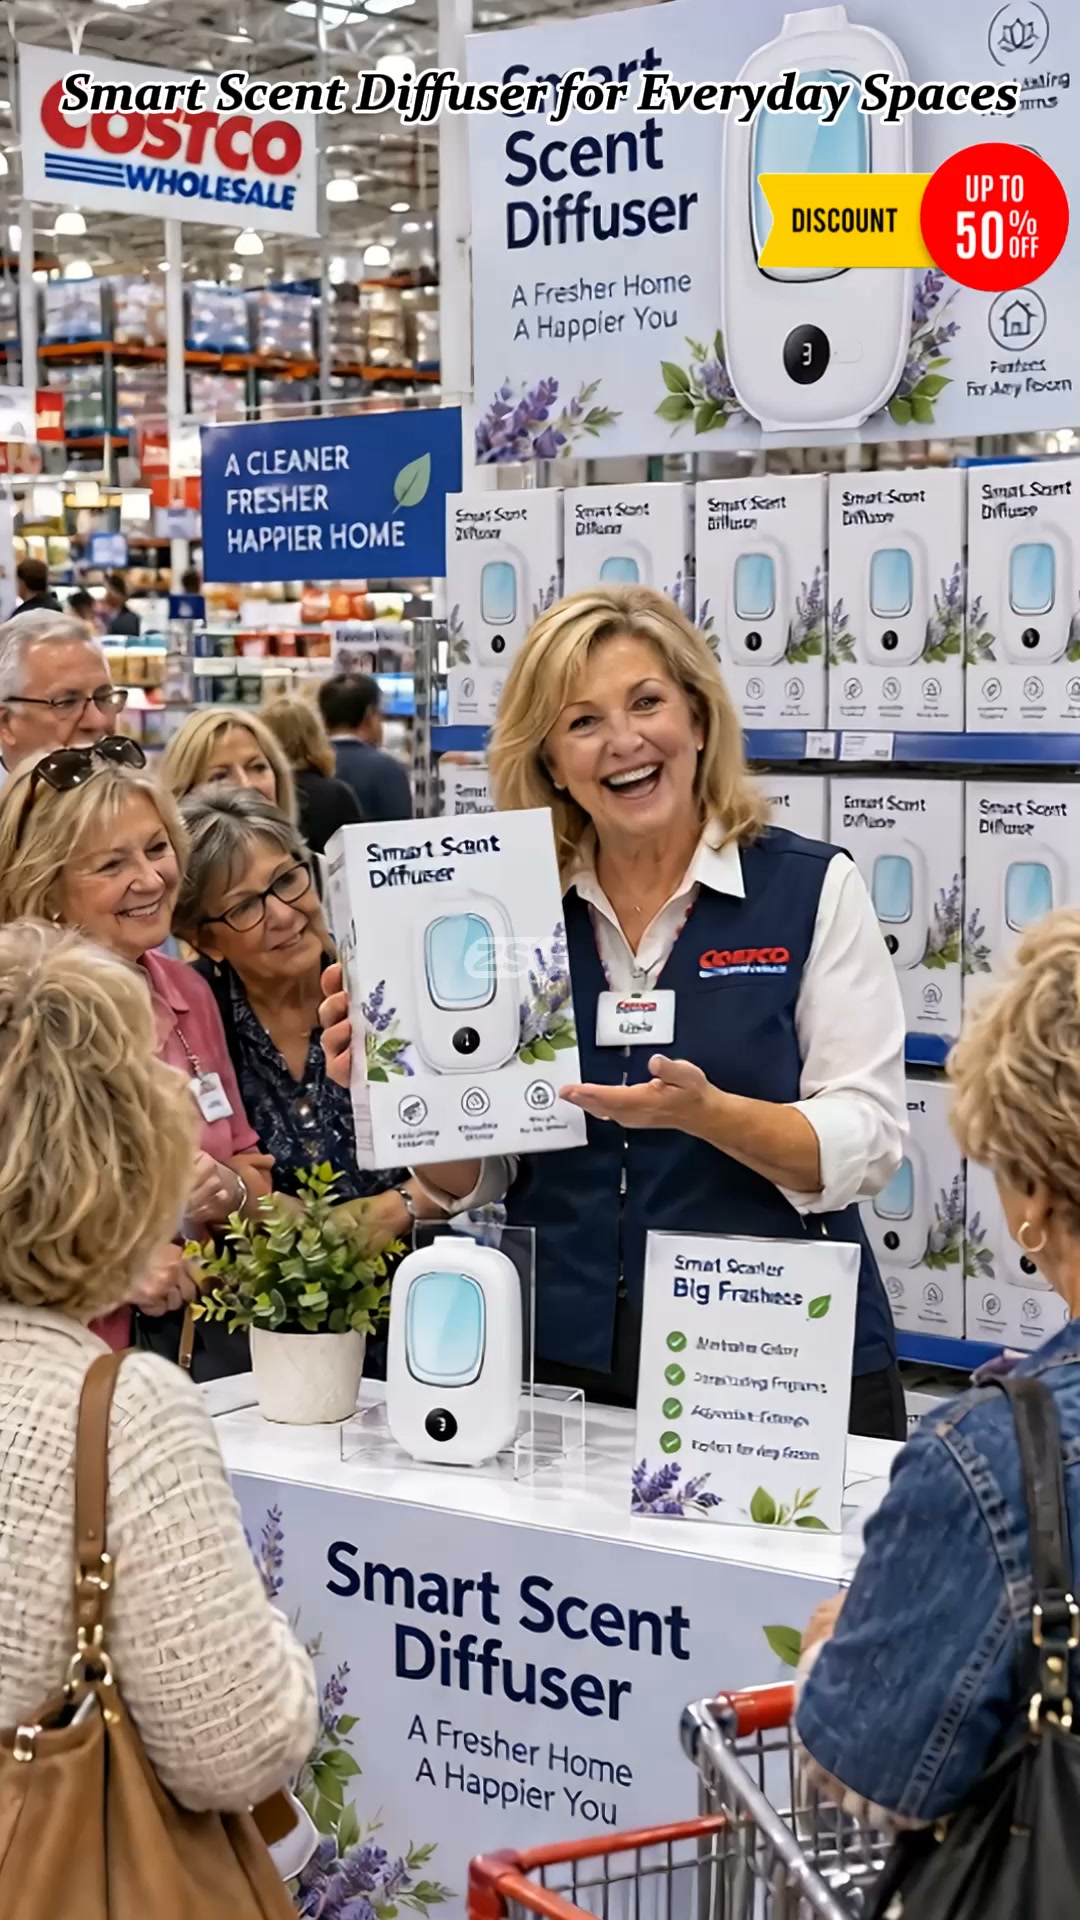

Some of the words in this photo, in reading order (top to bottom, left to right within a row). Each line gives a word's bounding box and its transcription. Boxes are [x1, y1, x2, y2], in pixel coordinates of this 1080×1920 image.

[41, 78, 302, 175] COSTCO
[505, 118, 663, 187] Scent
[124, 165, 297, 211] WHOLESALE
[507, 190, 698, 249] Diffuser
[511, 284, 528, 308] A
[534, 278, 617, 306] Fresher
[624, 274, 692, 297] Home
[513, 318, 530, 341] A
[537, 311, 625, 343] Happier
[633, 306, 678, 330] You
[224, 453, 240, 477] A
[247, 445, 349, 476] CLEANER
[227, 484, 329, 515] FRESHER
[228, 524, 323, 553] HAPPIER
[330, 521, 405, 549] HOME
[673, 1277, 710, 1305] Big
[326, 1541, 500, 1625] Smart
[519, 1575, 690, 1660] Scent
[395, 1623, 632, 1721] Diffuser
[407, 1714, 428, 1744] A
[436, 1719, 540, 1766] Fresher
[548, 1743, 633, 1787] Home
[415, 1757, 436, 1786] A
[445, 1762, 555, 1811] Happier
[563, 1787, 617, 1826] You
